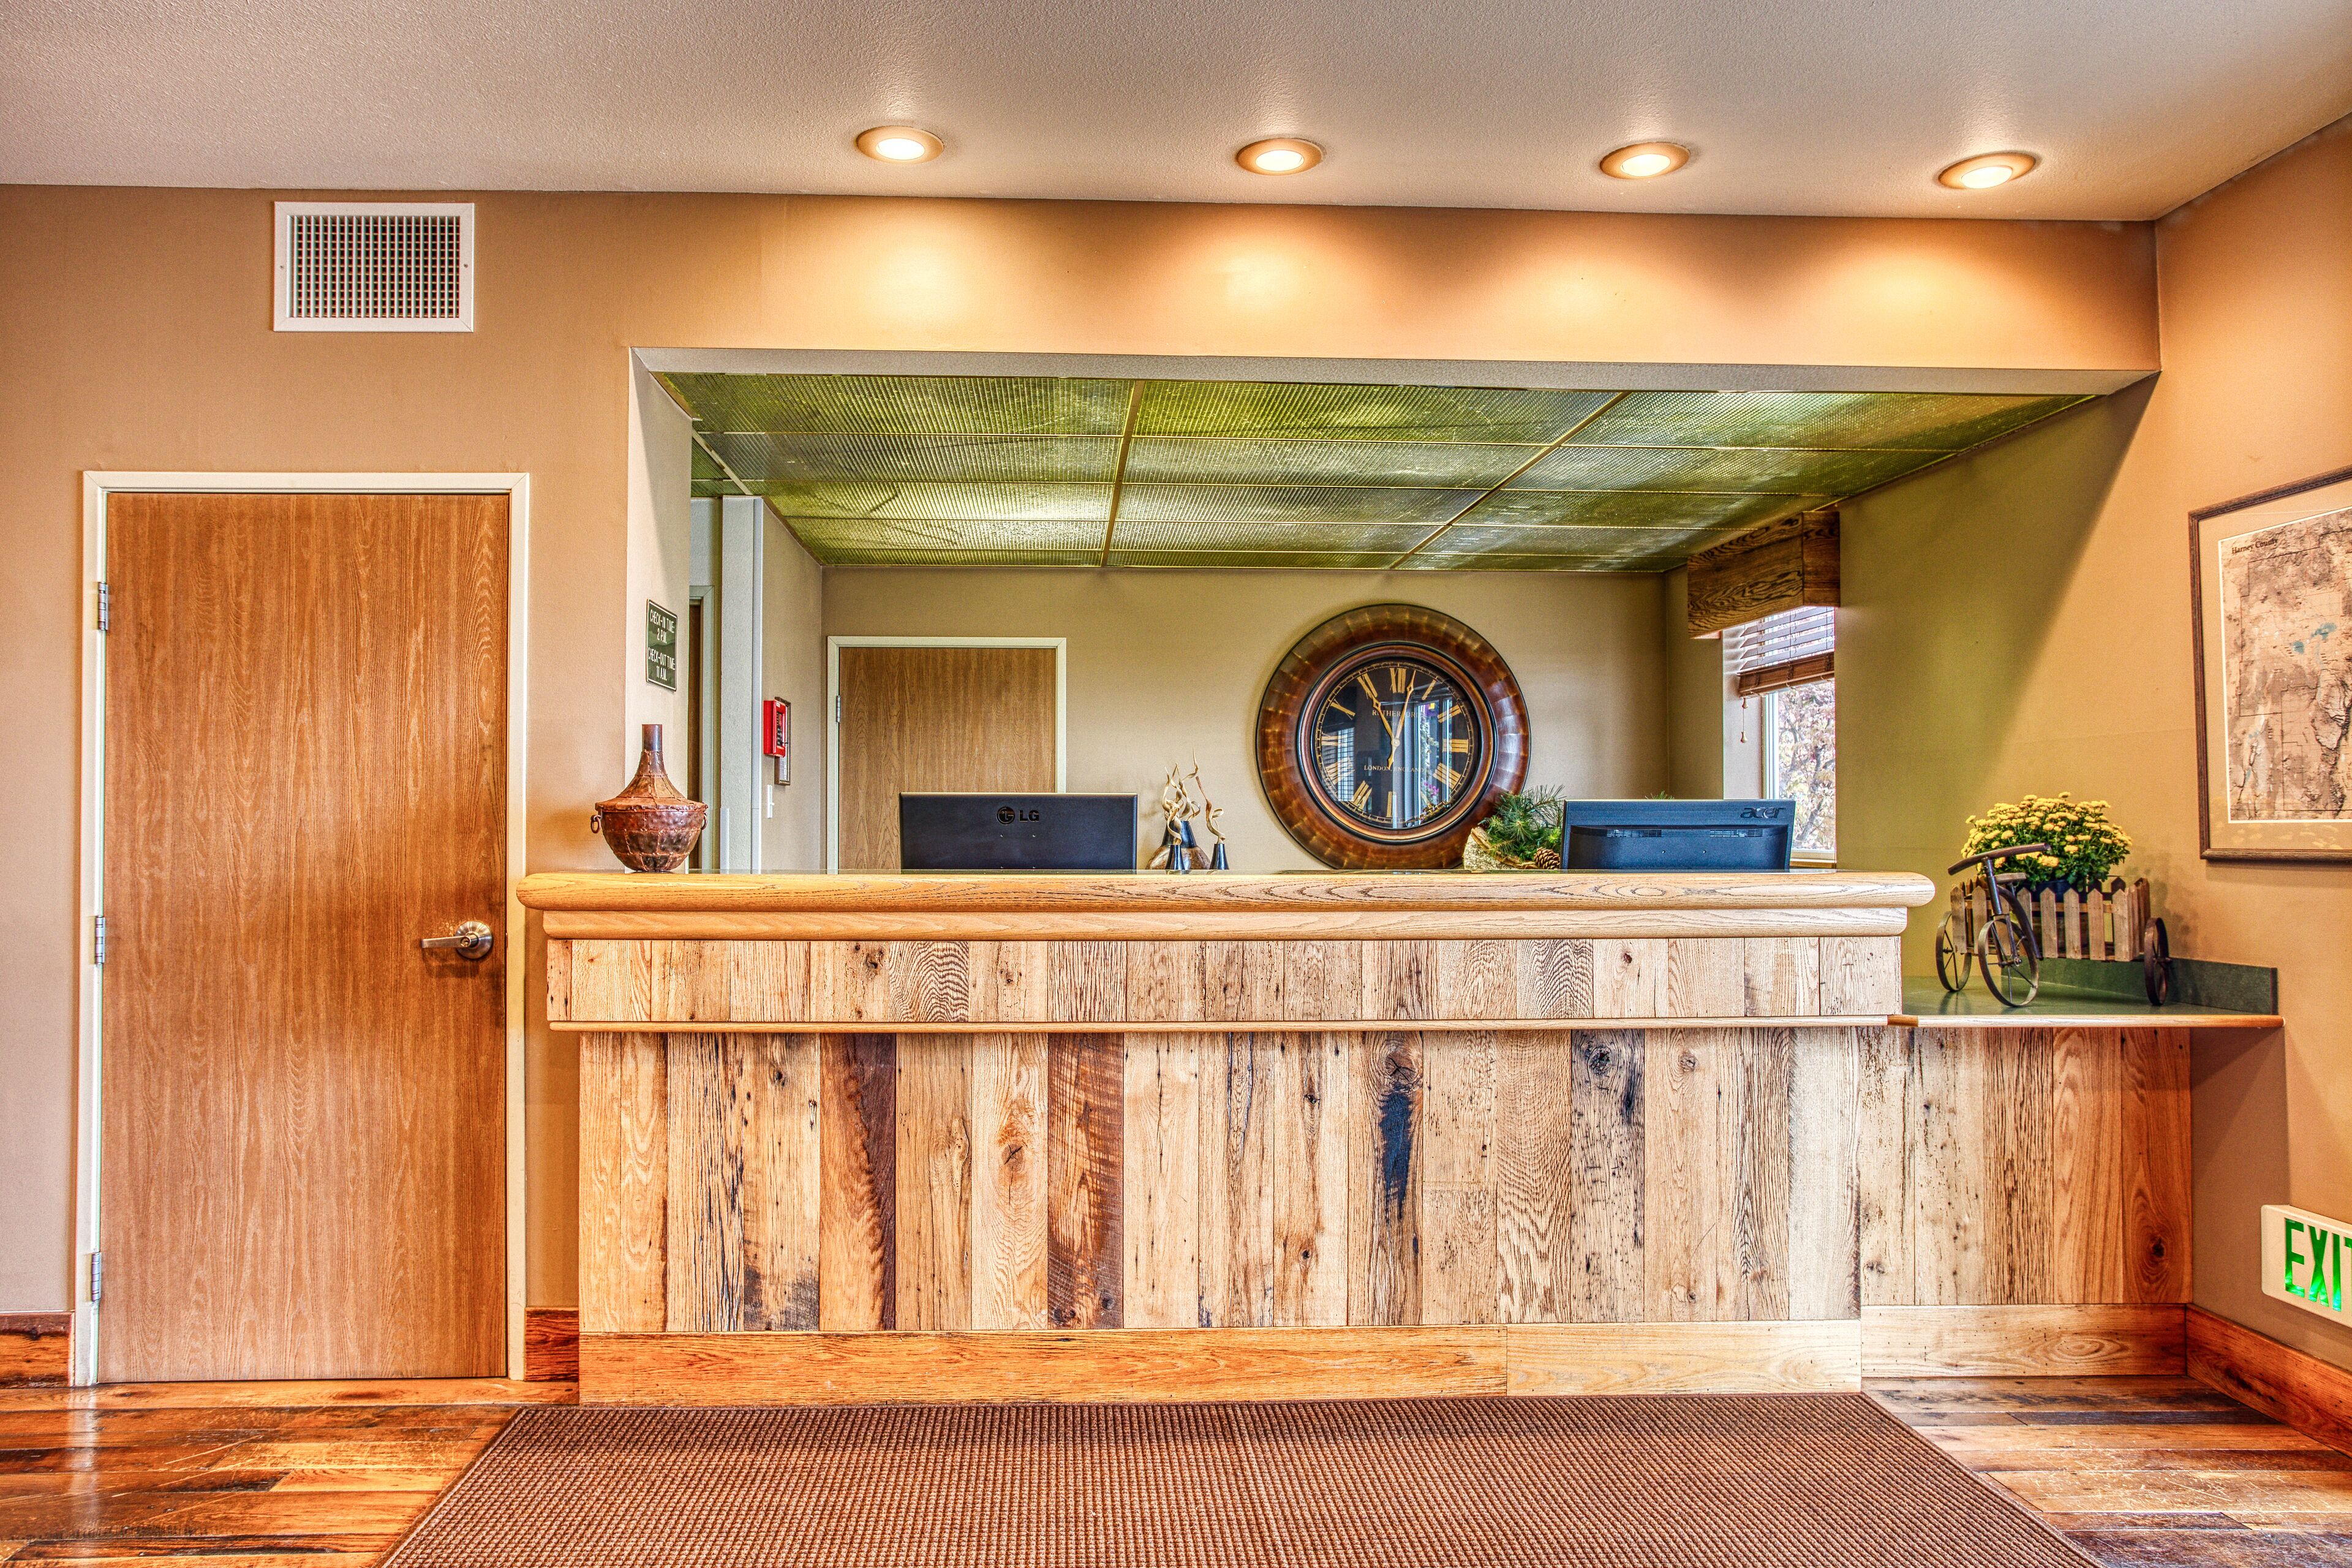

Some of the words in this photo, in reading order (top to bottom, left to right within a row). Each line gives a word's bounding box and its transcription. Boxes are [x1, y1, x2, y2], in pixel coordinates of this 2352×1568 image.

[2231, 545, 2254, 554] Harney
[2255, 539, 2278, 548] County
[650, 609, 666, 629] CHECK-IN
[657, 628, 660, 641] 2
[648, 647, 666, 666] CHECK-OUT
[657, 666, 660, 678] 11
[1389, 668, 1407, 694] XII
[1019, 809, 1039, 822] LG
[1740, 807, 1787, 819] acer
